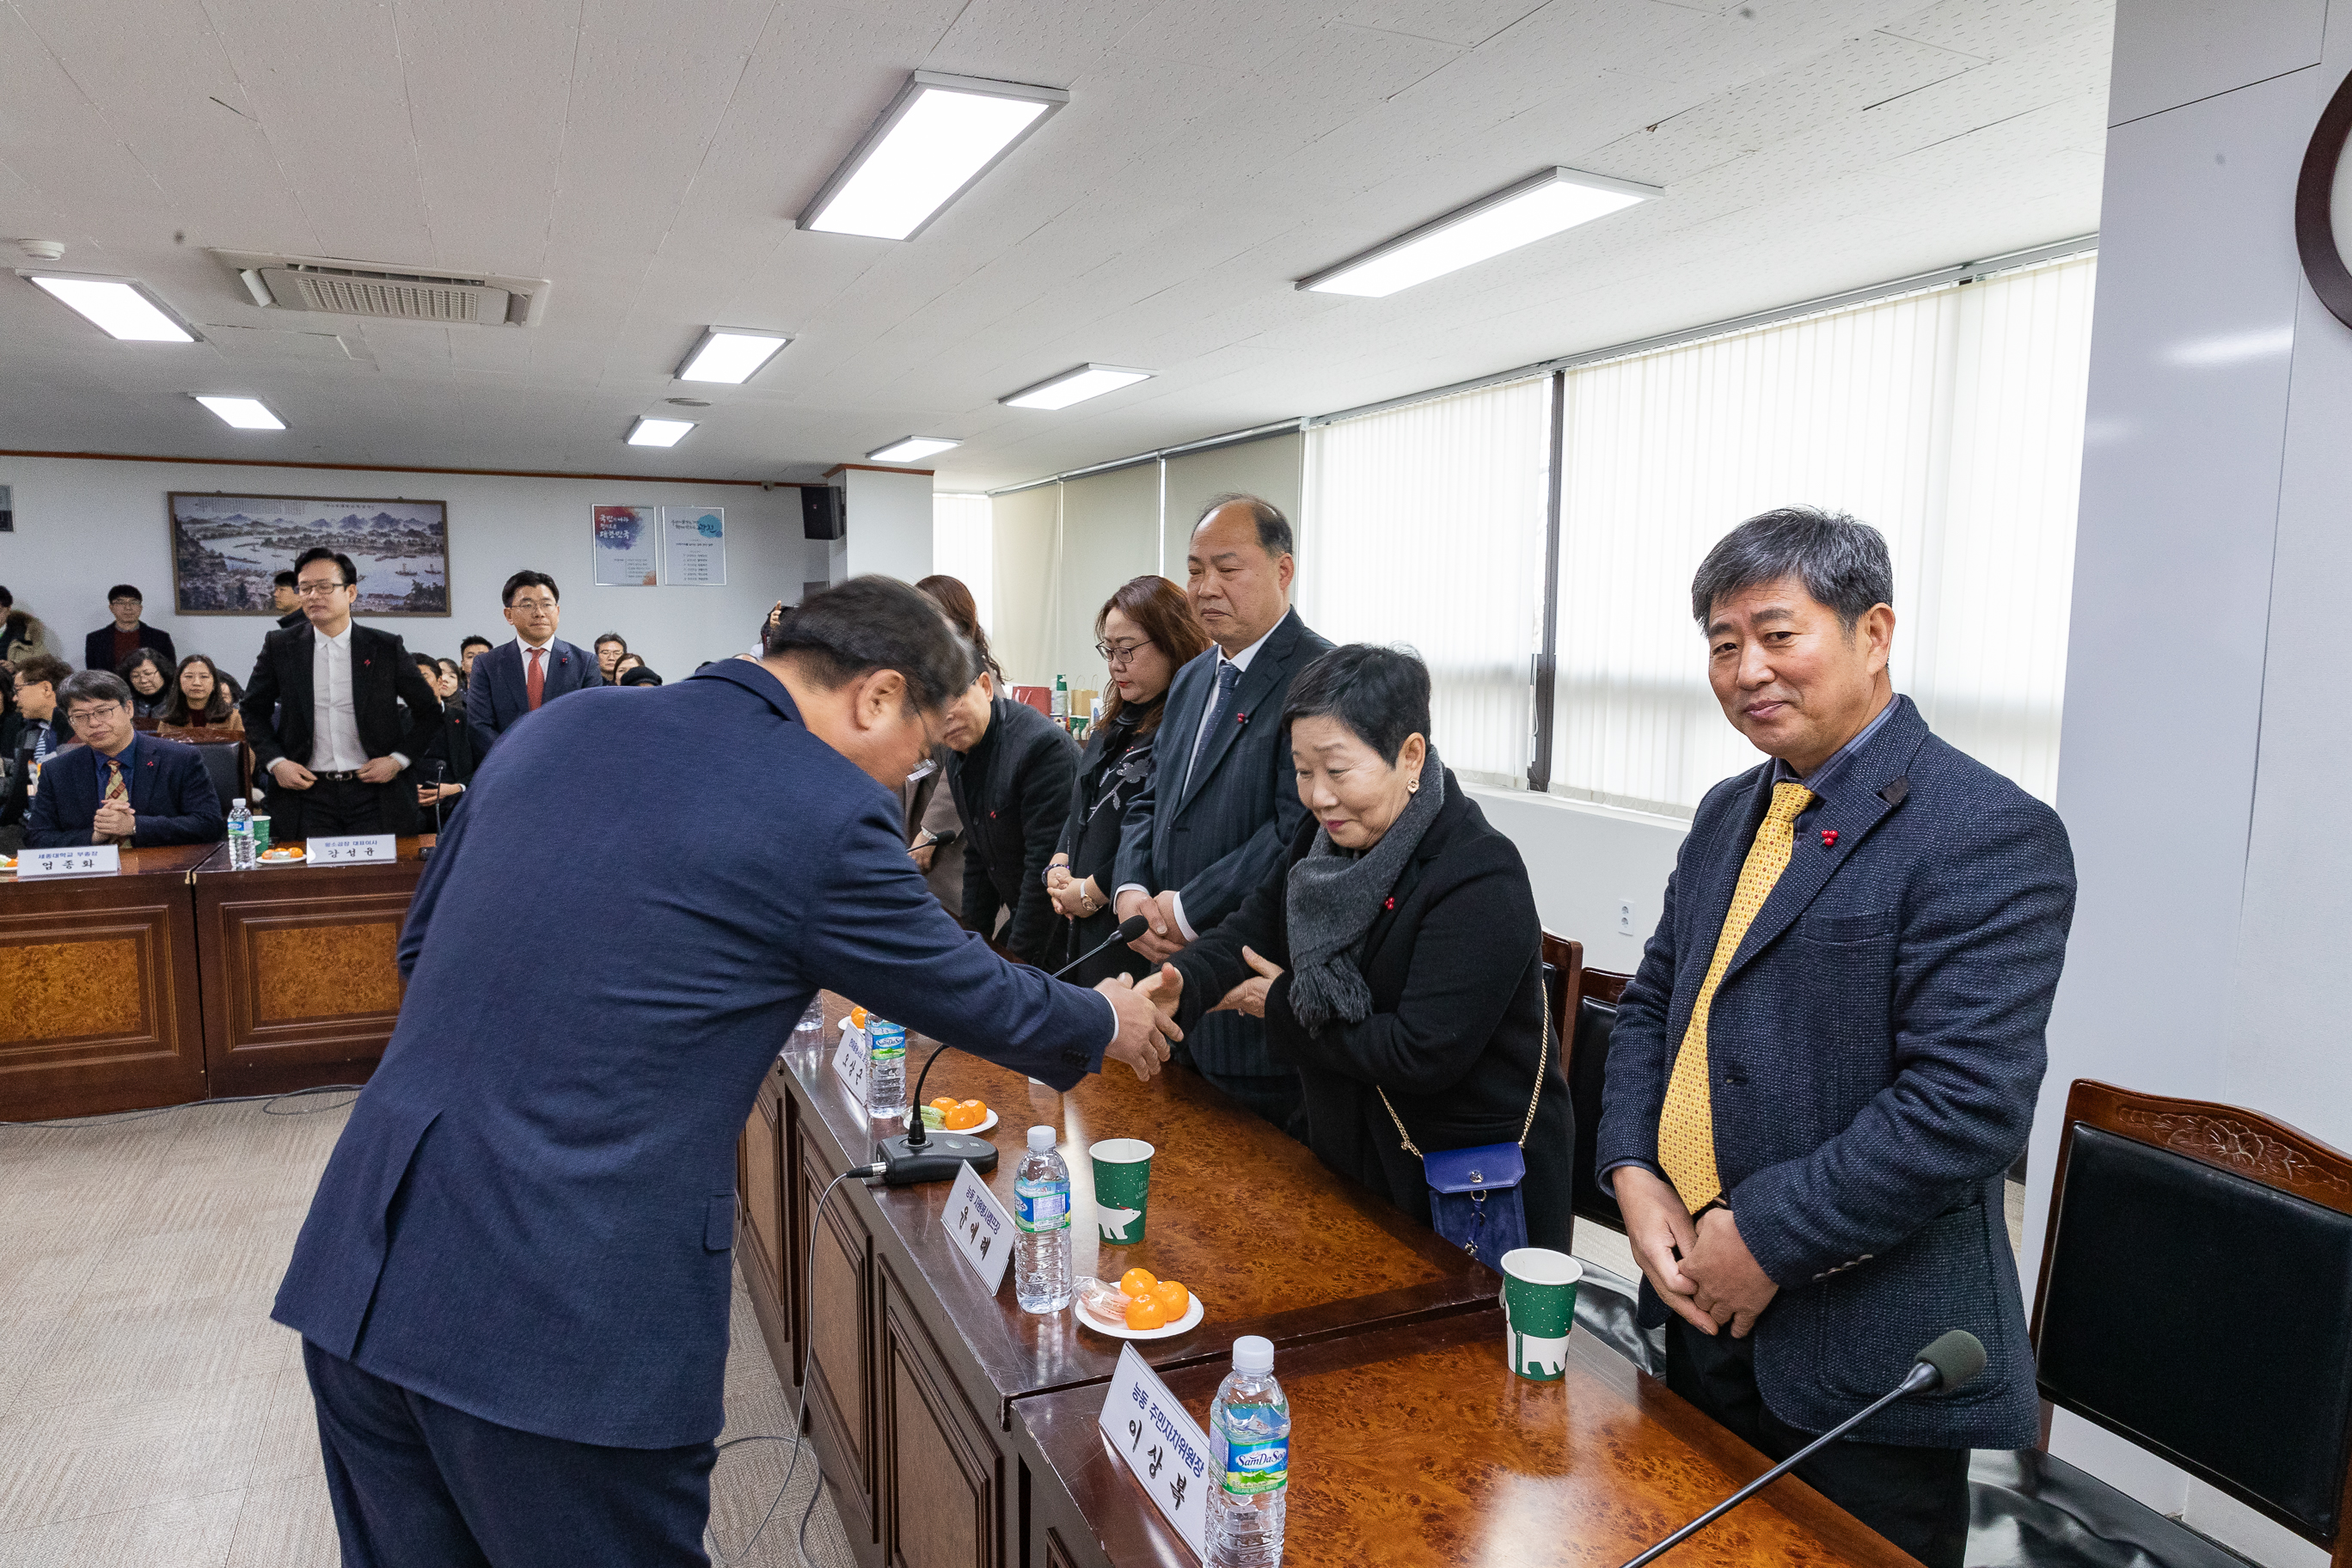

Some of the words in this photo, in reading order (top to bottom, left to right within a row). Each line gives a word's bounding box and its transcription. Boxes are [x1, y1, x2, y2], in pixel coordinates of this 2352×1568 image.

[599, 530, 629, 539] 대한민국
[965, 1185, 976, 1202] 능동
[974, 1195, 1001, 1234] 자원봉사캠프장
[1129, 1419, 1142, 1453] 이
[1131, 1381, 1149, 1410] 능동
[1148, 1402, 1205, 1478] 주민자치위원장
[1238, 1450, 1286, 1467] SamDaSoo
